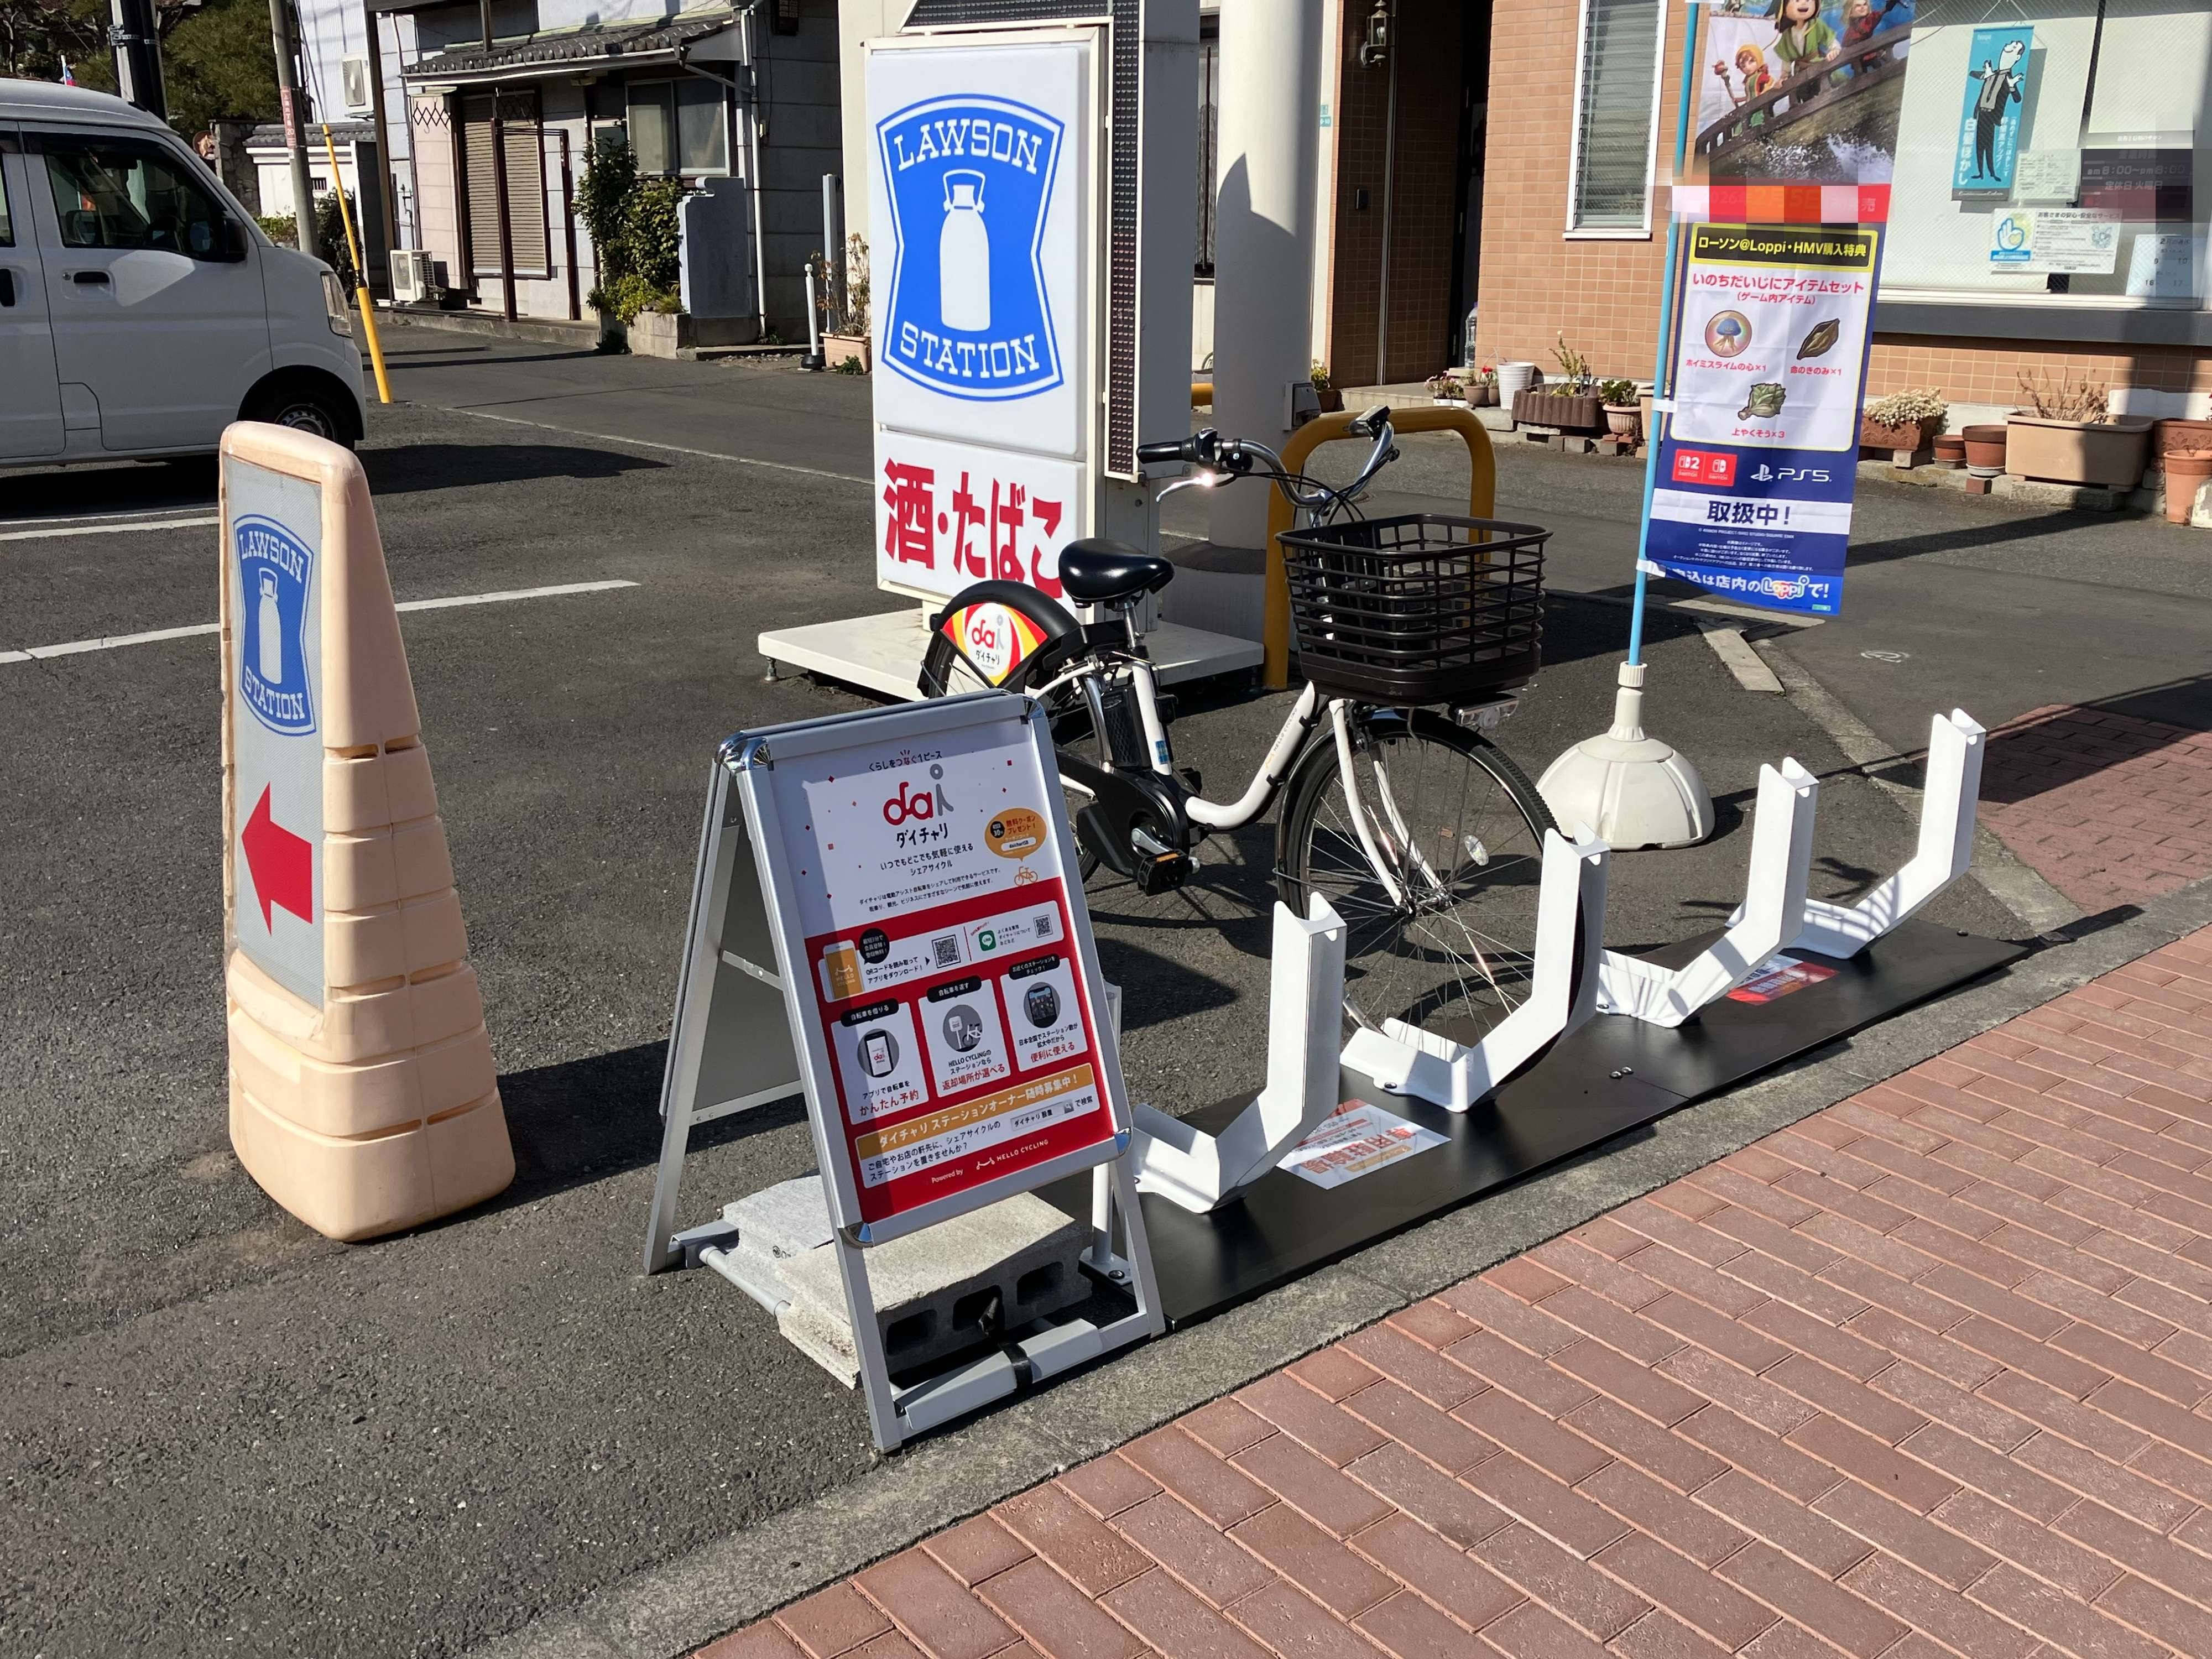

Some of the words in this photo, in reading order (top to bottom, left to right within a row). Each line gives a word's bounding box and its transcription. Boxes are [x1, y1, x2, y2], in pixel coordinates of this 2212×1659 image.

[894, 118, 1042, 175] LAWSON
[1693, 273, 1865, 294] いのちだいじにアイテムセット
[1736, 291, 1816, 305] (ゲーム内アイテム)
[899, 320, 1040, 380] STATION
[1777, 467, 1830, 482] PS5
[1707, 500, 1791, 526] 取扱中！
[884, 457, 1063, 600] 酒・たばこ
[238, 533, 304, 584] LAWSON
[972, 614, 1004, 650] dai
[975, 650, 1000, 665] ダイチャリ
[244, 664, 306, 720] STATION
[869, 750, 943, 771] くらしをつなぐ1ピース
[883, 763, 954, 825] dai
[895, 822, 948, 849] ダイチャリ
[879, 842, 974, 871] いつでもどこでも気軽に使える
[910, 859, 953, 877] シェアサイクル
[866, 956, 919, 975] QRコードを読み取って
[868, 964, 922, 984] アプリをダウンロード！
[938, 982, 969, 997] 自転車を返す
[850, 1004, 889, 1021] 自転車を借りる
[948, 1057, 965, 1067] HELLO
[1030, 1041, 1075, 1063] 便利に使える
[950, 1057, 992, 1075] ステーションなら
[942, 1063, 1005, 1091] 返却場所が選べる
[862, 1081, 910, 1100] アプリで自転車を
[1074, 1095, 1093, 1107] で検索
[859, 1089, 919, 1117] かんたん予約
[1014, 1113, 1041, 1127] ダイチャリ
[1041, 1108, 1053, 1119] 設置
[867, 1120, 1001, 1172] ご自宅やお店の軒先に、シェアサイクルの
[996, 1149, 1019, 1162] HELLO
[1020, 1139, 1049, 1154] CYCLING
[870, 1142, 968, 1182] ステーションを置きませんか？
[931, 1171, 955, 1184] Powered
[956, 1168, 963, 1177] by
